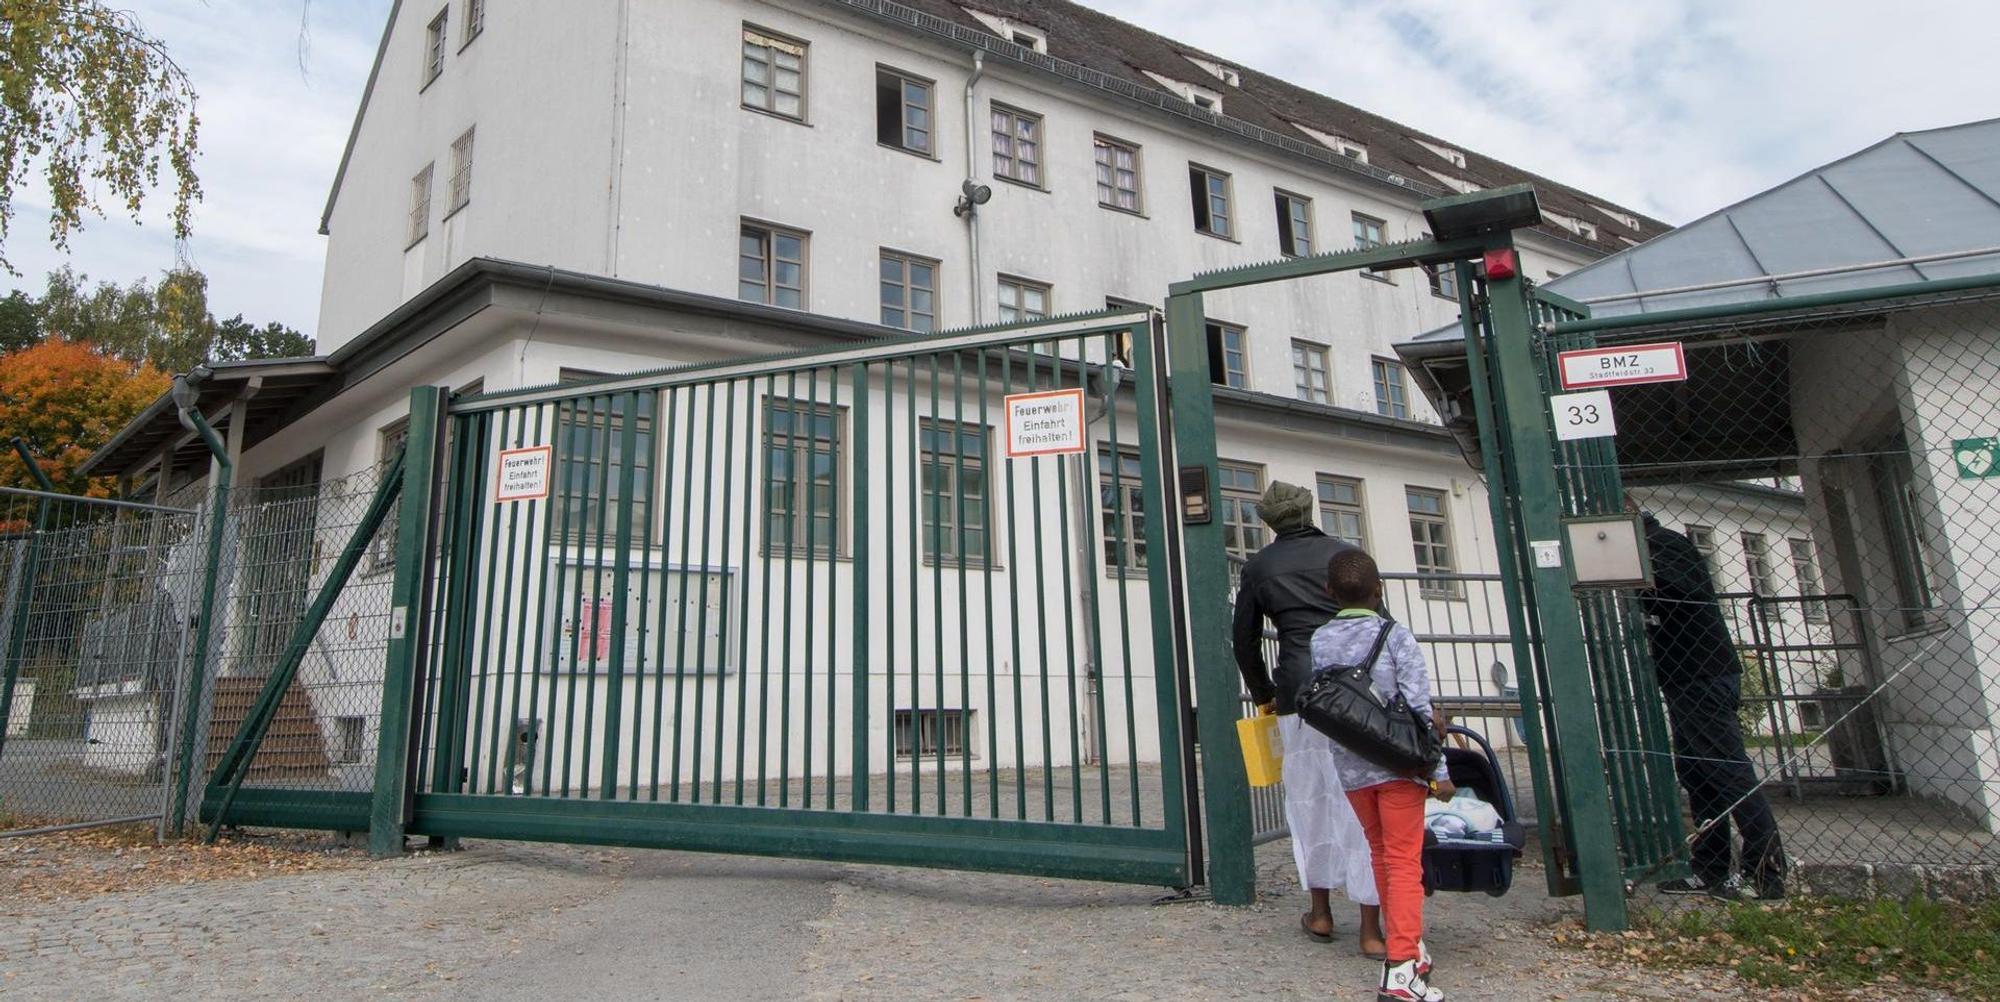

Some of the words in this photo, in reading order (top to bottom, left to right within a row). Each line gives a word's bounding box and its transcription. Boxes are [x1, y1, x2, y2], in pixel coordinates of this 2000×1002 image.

[1600, 354, 1640, 369] BMZ
[1567, 404, 1600, 425] 33
[1023, 417, 1066, 432] Einfahrt
[1018, 430, 1073, 445] freihalten!
[504, 455, 545, 469] Feuerwehr!
[509, 470, 538, 481] Einfahrt
[503, 480, 542, 491] freihalten!
